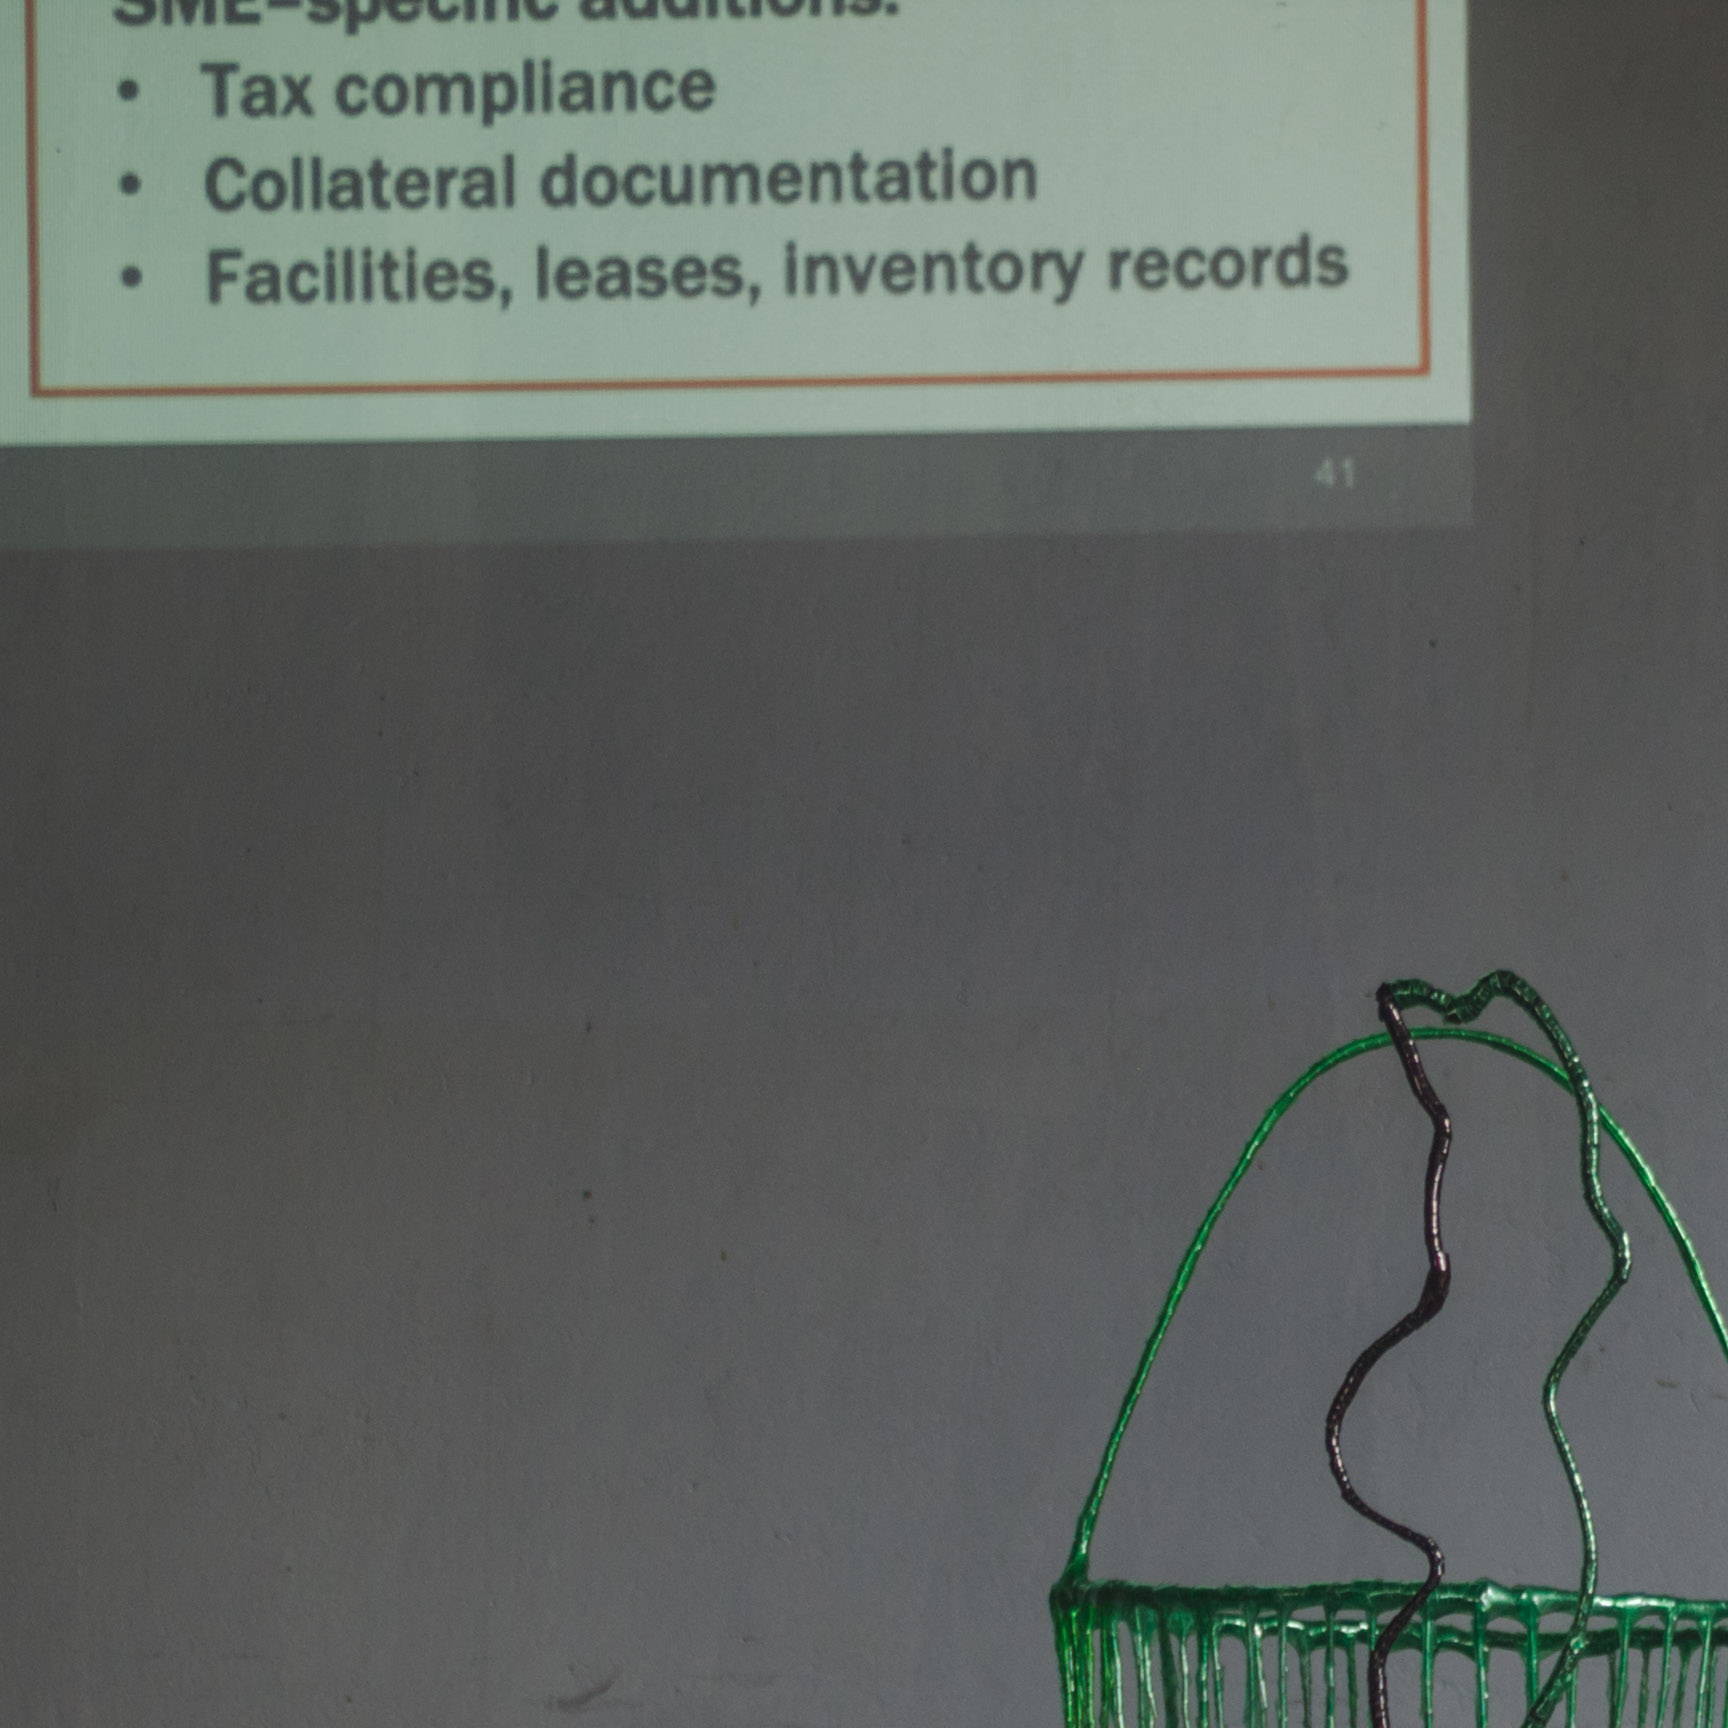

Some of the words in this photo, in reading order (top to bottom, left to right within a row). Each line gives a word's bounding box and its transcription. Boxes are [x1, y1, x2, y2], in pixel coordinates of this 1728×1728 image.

[199, 61, 315, 118] Tax
[335, 57, 717, 127] compliance
[204, 153, 515, 213] Collateral
[540, 146, 1038, 207] documentation
[207, 245, 513, 311] Facilities,
[535, 243, 761, 307] leases,
[784, 239, 1085, 305] inventory
[1108, 232, 1350, 291] records
[1313, 457, 1355, 490] 41
